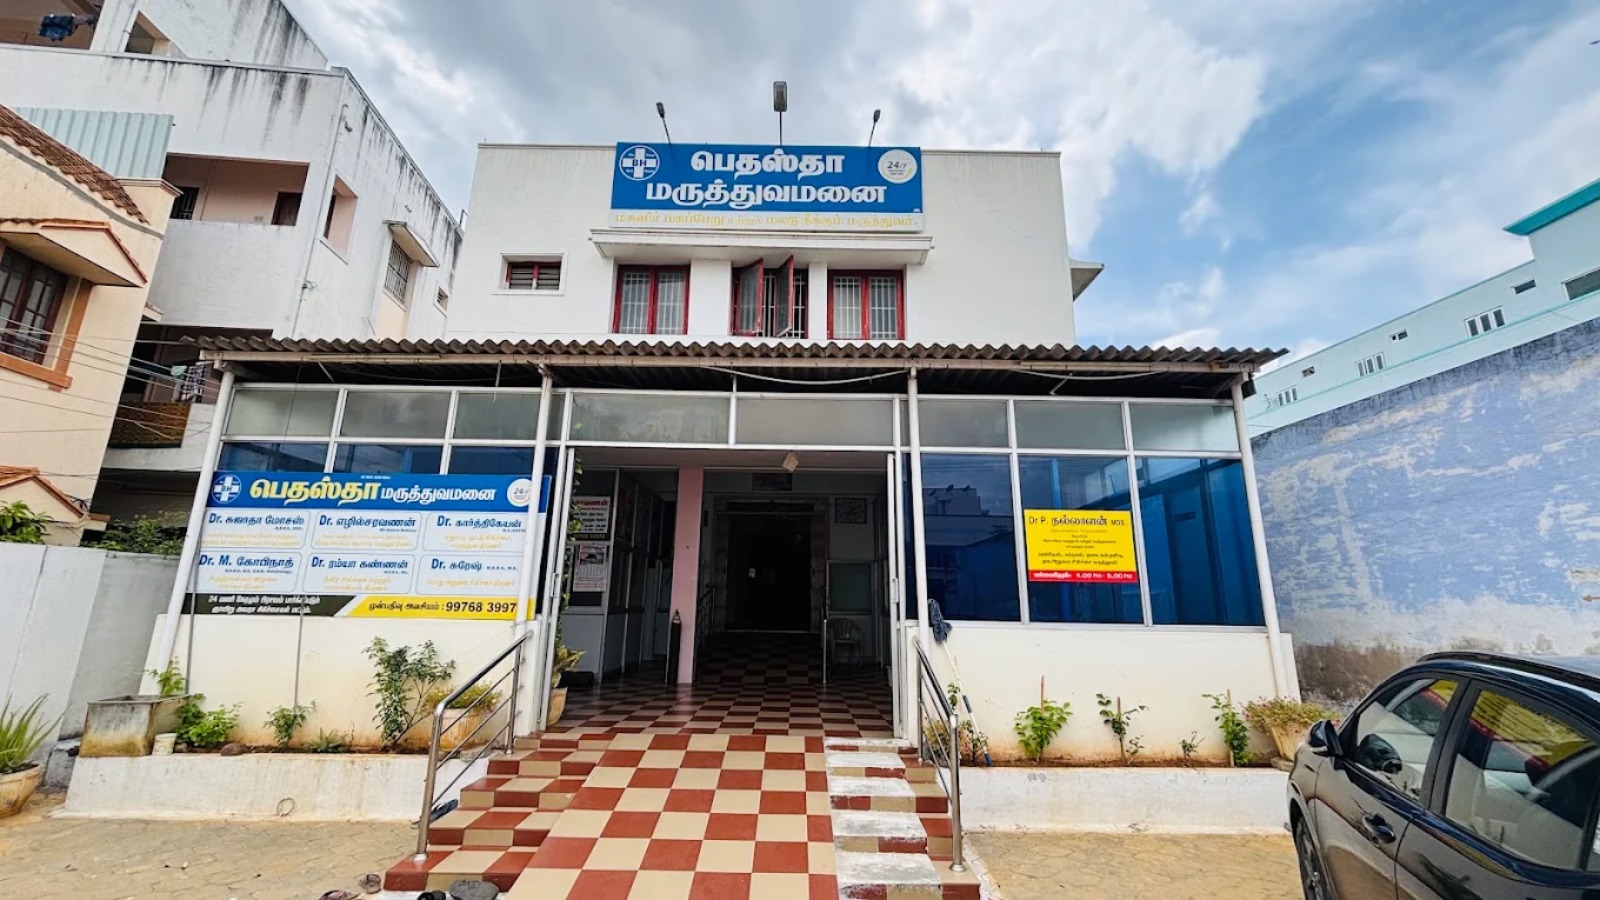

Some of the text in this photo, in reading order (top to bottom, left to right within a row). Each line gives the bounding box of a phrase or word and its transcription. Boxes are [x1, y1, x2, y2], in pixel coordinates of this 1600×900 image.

[631, 159, 647, 168] BH
[691, 148, 845, 181] பெதஸ்தா
[646, 178, 887, 209] மருத்துவமனை
[250, 475, 497, 507] பெதஸ்தா மருத்துவமனை
[209, 513, 222, 524] Dr.
[265, 514, 304, 525] மோசஸ்
[319, 514, 416, 529] Dr. எழில்சரவணன்
[437, 515, 522, 529] Dr. கார்த்திகேயன்
[199, 554, 294, 568] Dr. M. கோபிநாத்
[311, 556, 408, 569] Dr. ரம்யா கண்ணன்
[431, 558, 445, 569] Dr.
[449, 560, 482, 572] சுரேஷ்
[369, 600, 402, 611] முன்பதிவு
[404, 601, 439, 610] அவசியம்
[445, 601, 482, 613] 99768
[486, 602, 517, 614] 3997
